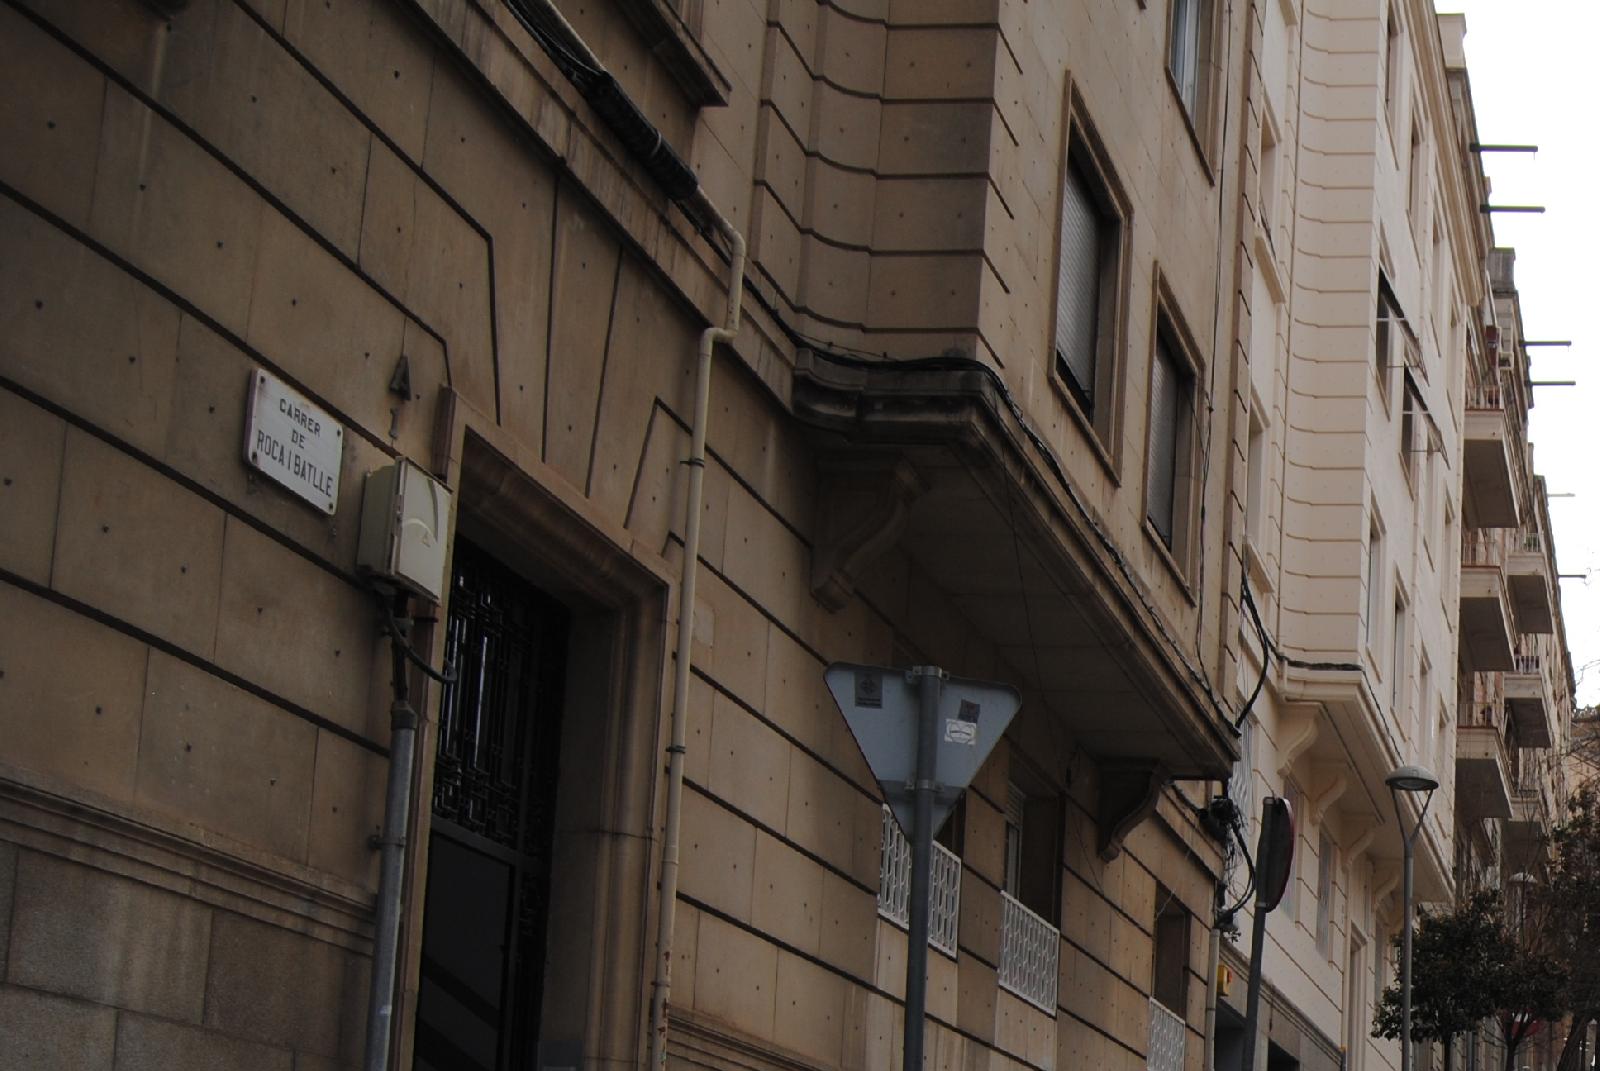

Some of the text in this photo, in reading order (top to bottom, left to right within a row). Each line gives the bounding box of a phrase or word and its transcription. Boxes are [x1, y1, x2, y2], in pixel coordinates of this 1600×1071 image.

[279, 398, 321, 437] CARRER
[291, 429, 306, 450] DE
[256, 429, 333, 497] ROCA I BATLLE
